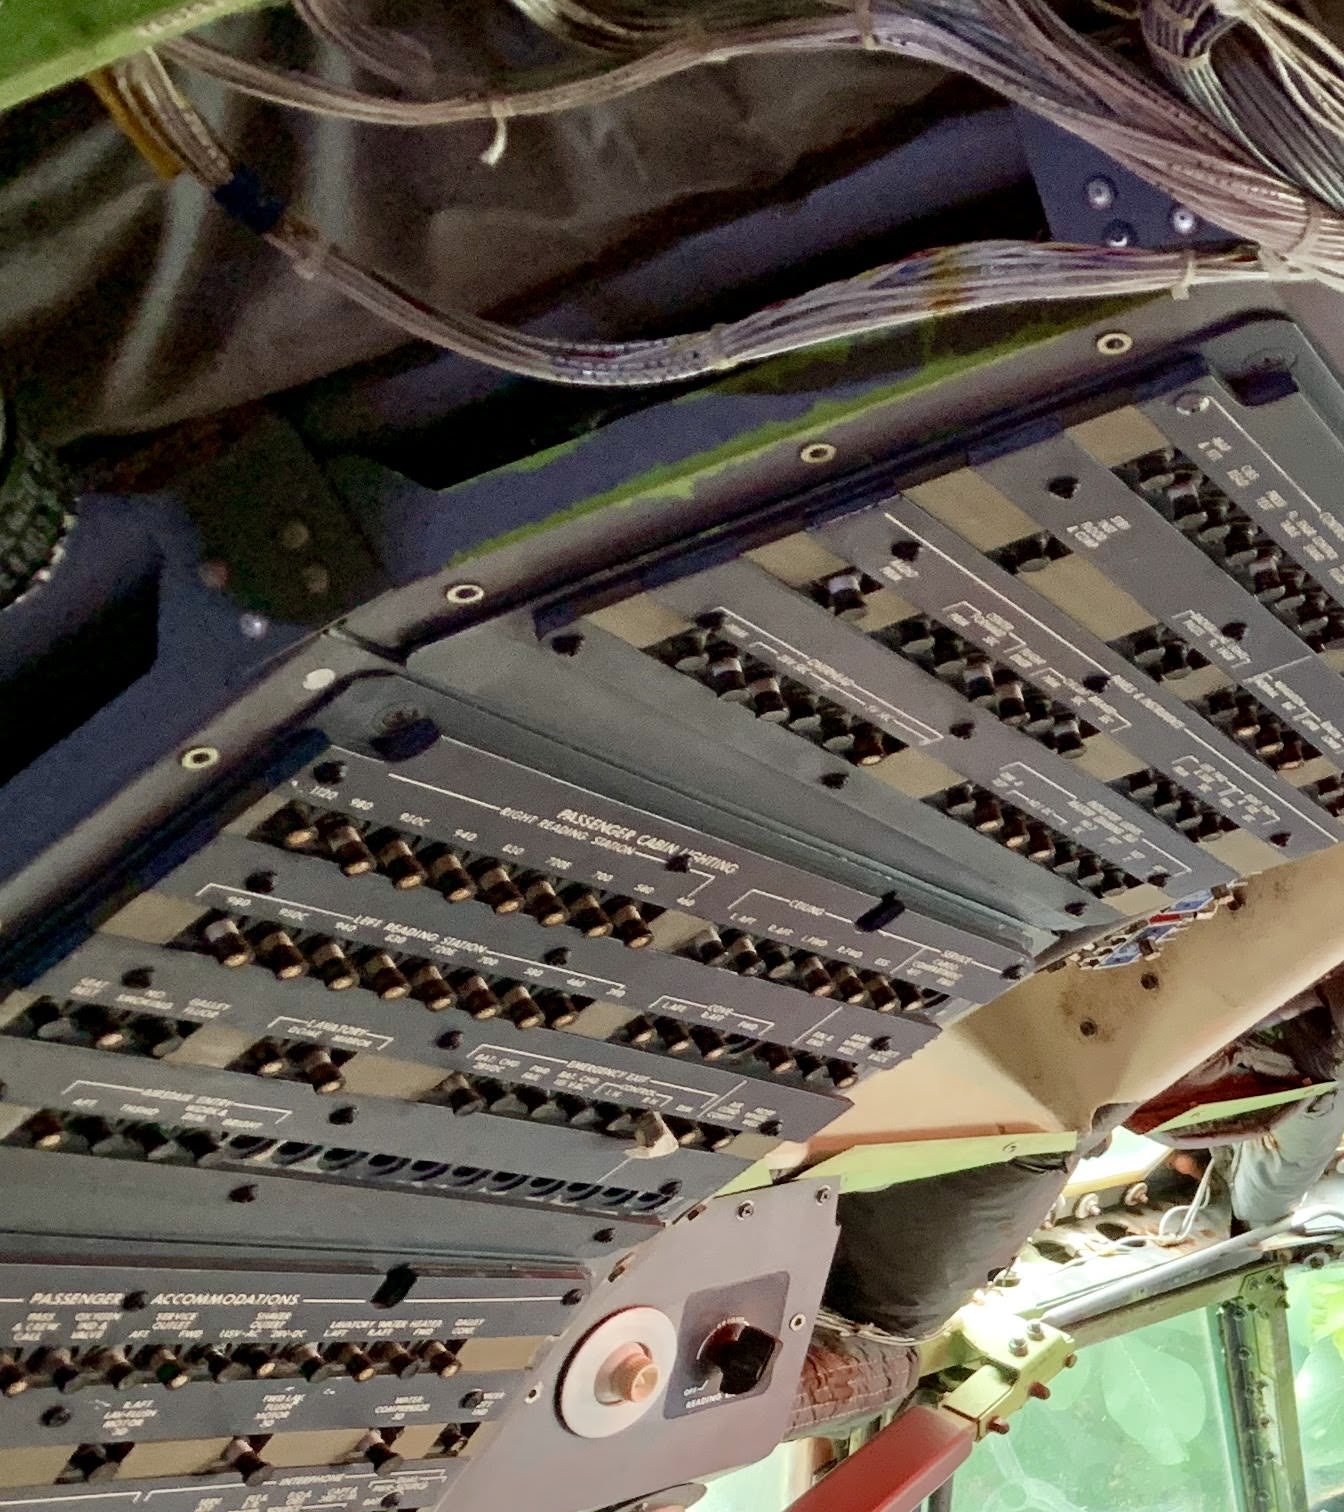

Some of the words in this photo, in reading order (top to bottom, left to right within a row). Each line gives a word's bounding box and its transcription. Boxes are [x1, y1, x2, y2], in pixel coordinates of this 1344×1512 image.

[499, 806, 539, 826] RIGHT
[537, 817, 590, 842] READING
[590, 835, 636, 856] STATION
[556, 808, 638, 840] PASSENGER
[636, 832, 681, 856] CABIN
[681, 846, 740, 875] LIGHTING
[353, 914, 384, 929] LEFT
[383, 922, 440, 942] READING
[440, 935, 488, 954] STATION
[29, 1292, 124, 1305] PASSENGER
[150, 1293, 301, 1305] ACCOMMODATIONS
[685, 1393, 722, 1409] READING
